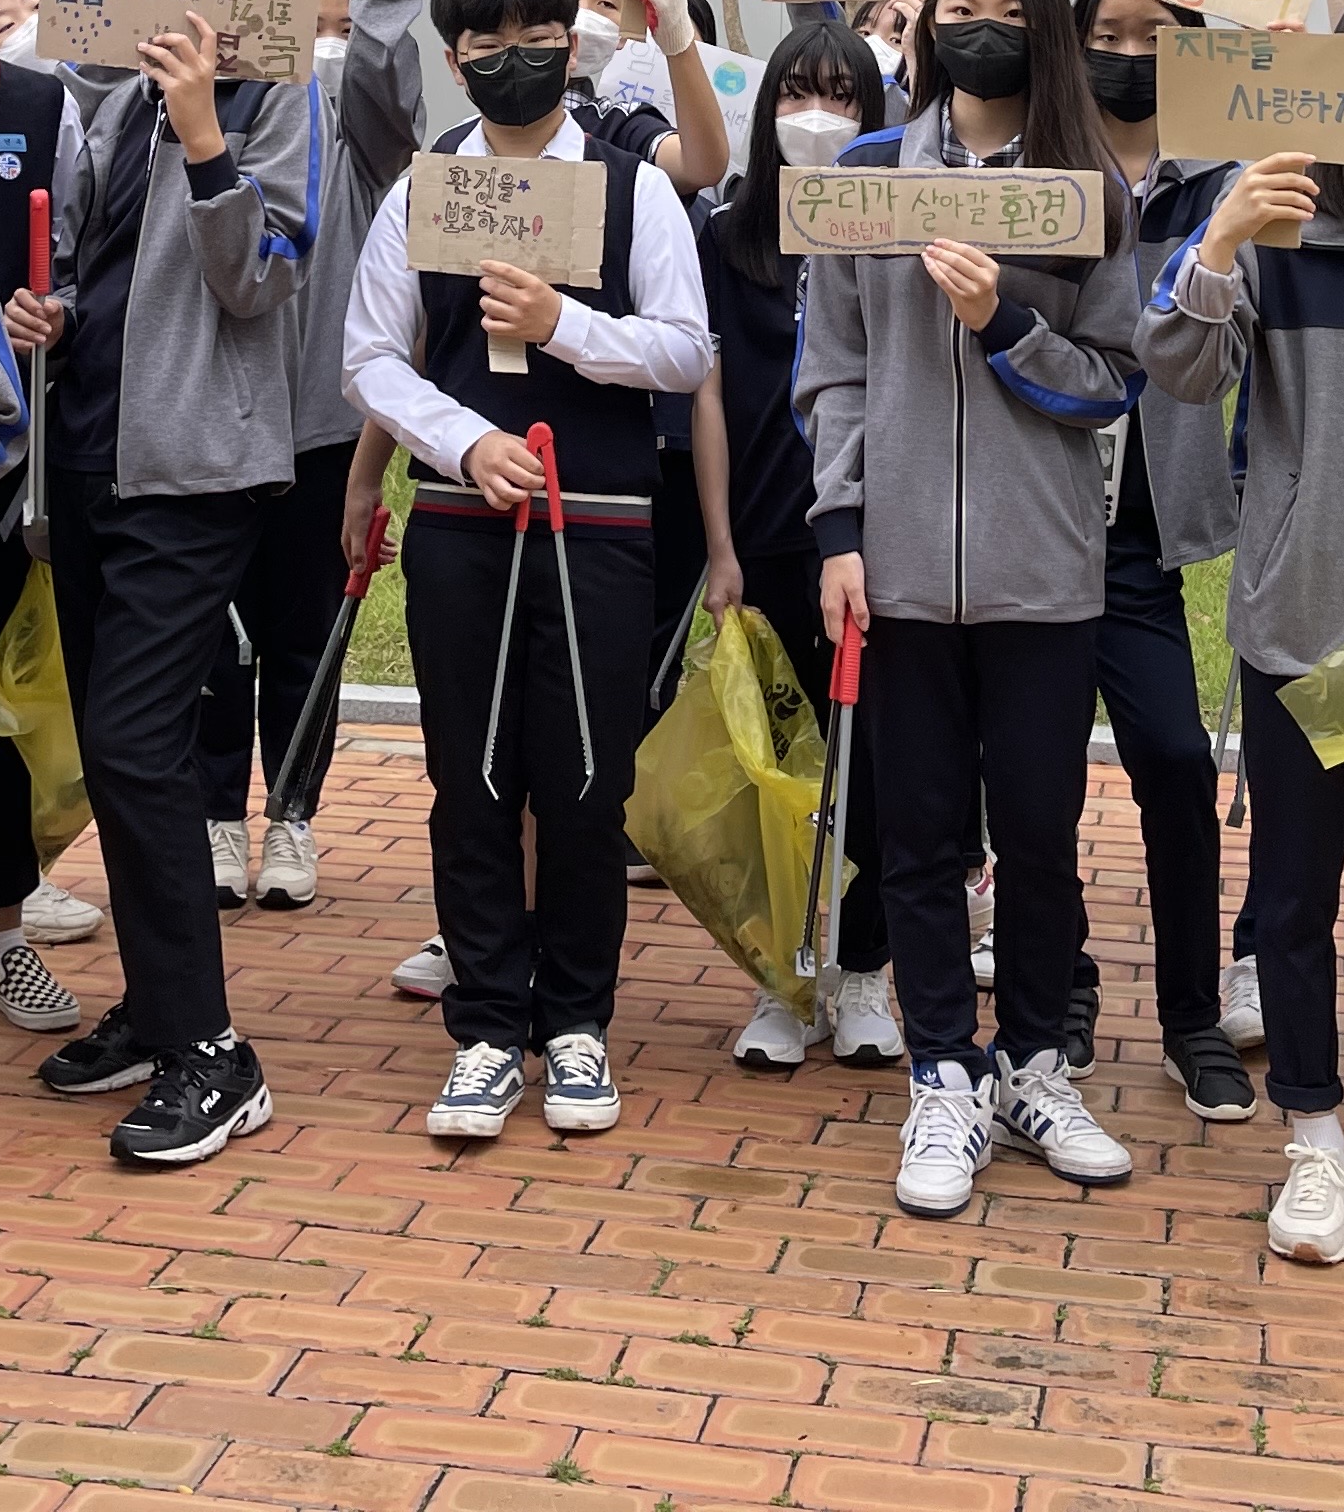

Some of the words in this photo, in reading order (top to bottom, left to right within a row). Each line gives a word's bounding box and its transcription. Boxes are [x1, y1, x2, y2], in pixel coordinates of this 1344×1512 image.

[1174, 32, 1279, 70] 지구를
[445, 166, 516, 205] 환경을
[797, 179, 899, 223] 우리가
[912, 188, 989, 233] 살아갈
[999, 184, 1066, 239] 환경
[200, 1089, 222, 1115] FILA
